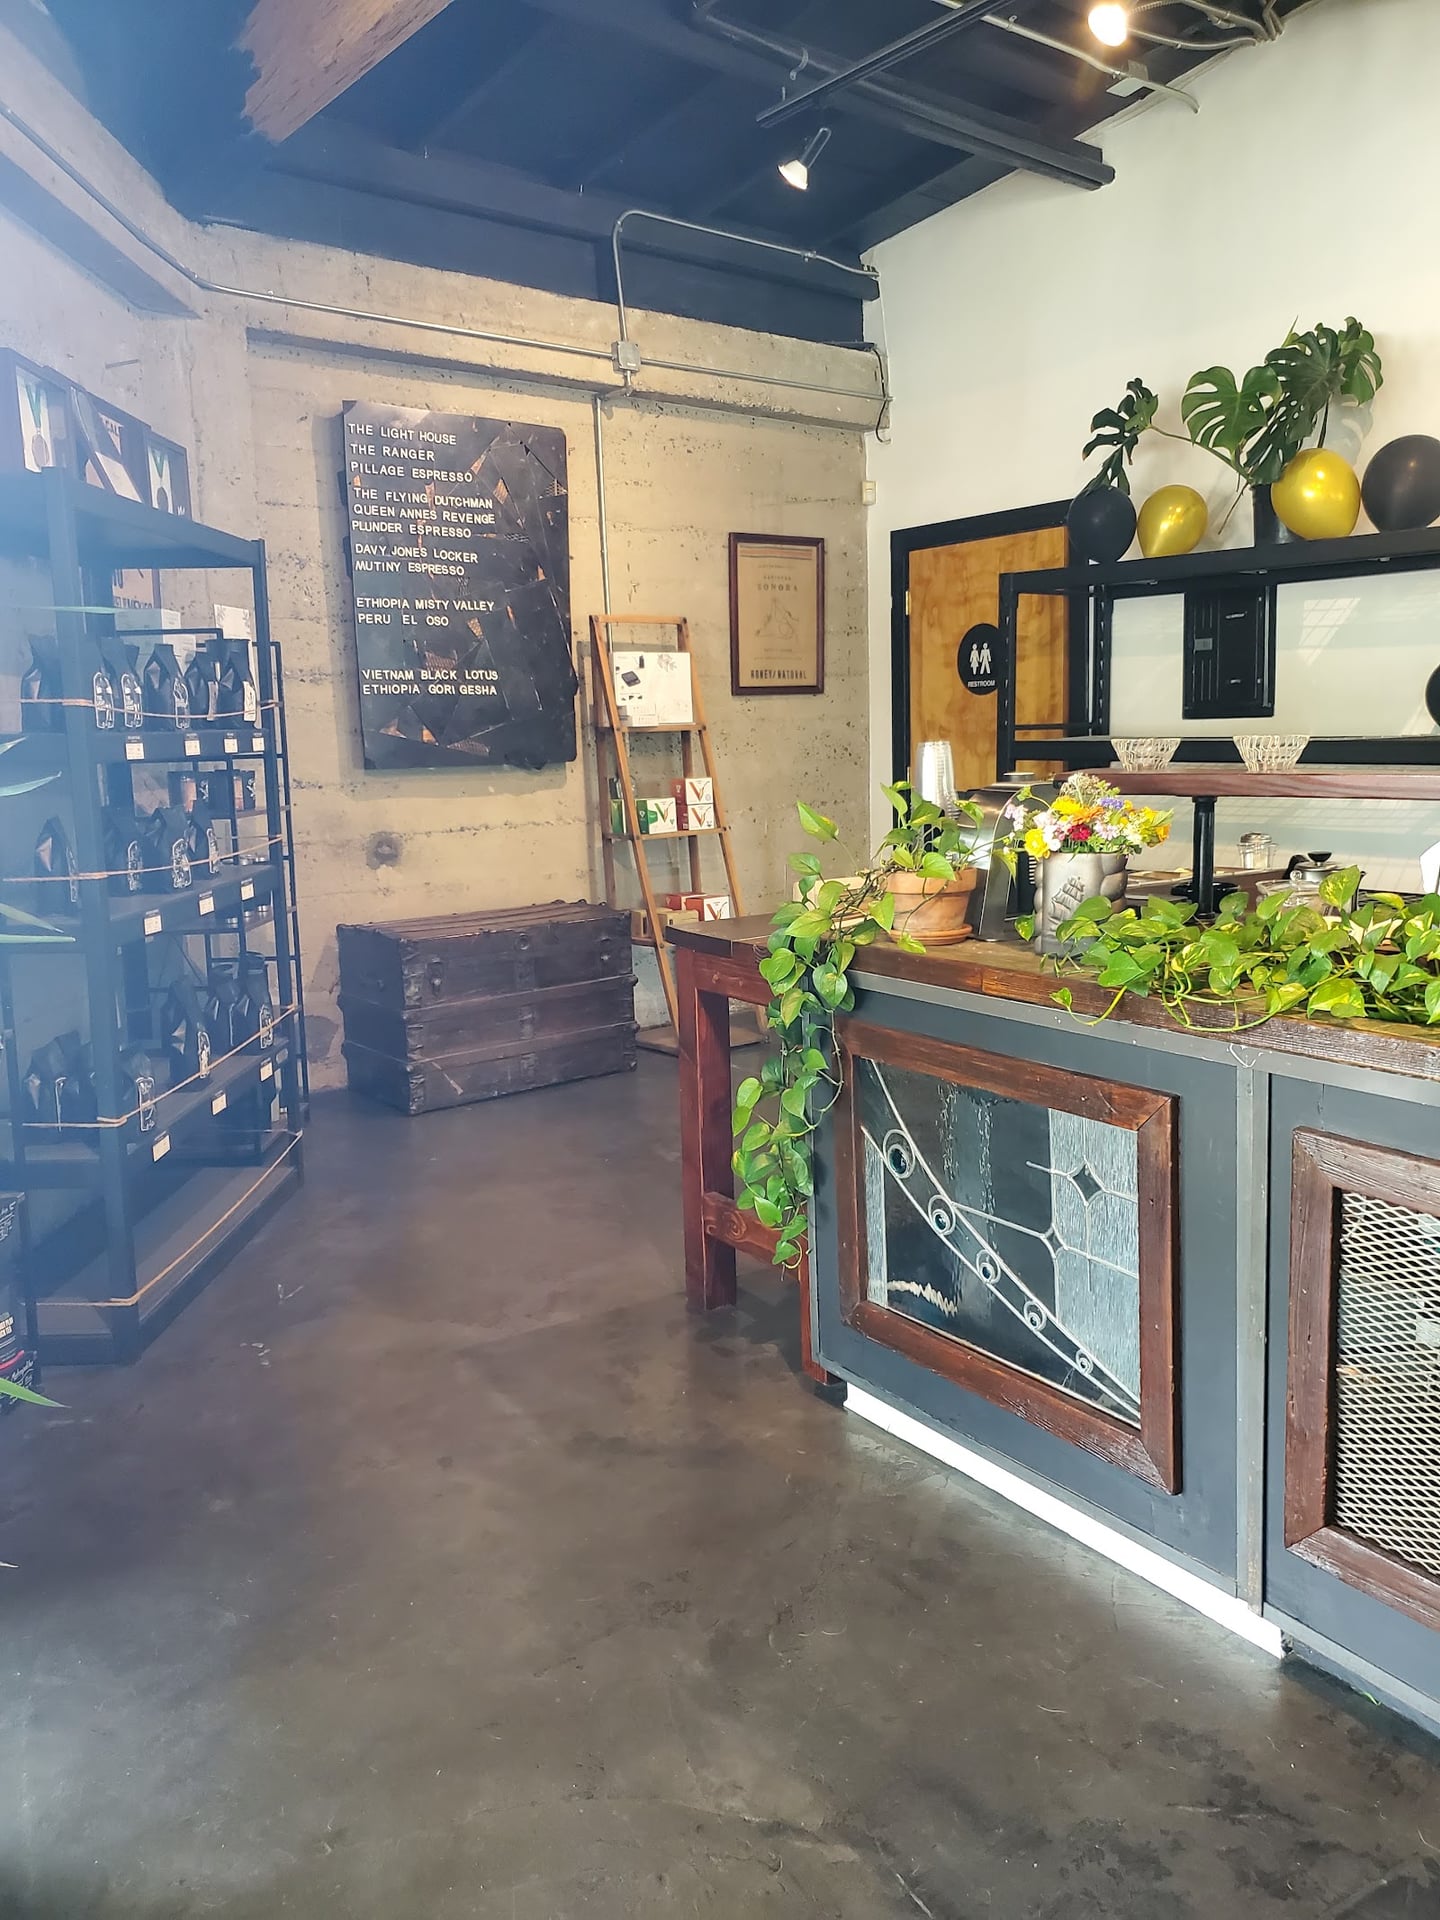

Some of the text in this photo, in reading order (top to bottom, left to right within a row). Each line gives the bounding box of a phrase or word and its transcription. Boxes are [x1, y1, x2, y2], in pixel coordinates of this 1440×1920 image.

[348, 422, 457, 446] THE LIGHT HOUSE
[350, 443, 435, 462] THE RANGER
[350, 461, 473, 483] PILLAGE ESPRESSO
[353, 487, 493, 510] THE FLYING DUTCHMAN
[353, 504, 496, 525] QUEEN ANNES REVENGE
[351, 520, 472, 539] PLUNDER ESPRESSO
[355, 543, 479, 564] DAVY JONES LOCKER
[355, 560, 465, 576] MUTINY ESPRESSO
[356, 597, 495, 612] ETHIOPIA MISTY VALLEY
[357, 613, 449, 627] PERU EL OSO
[361, 669, 499, 681] VIETNAM BLACK LOTUS
[362, 684, 497, 696] ETHIOPIA GORI GESHA
